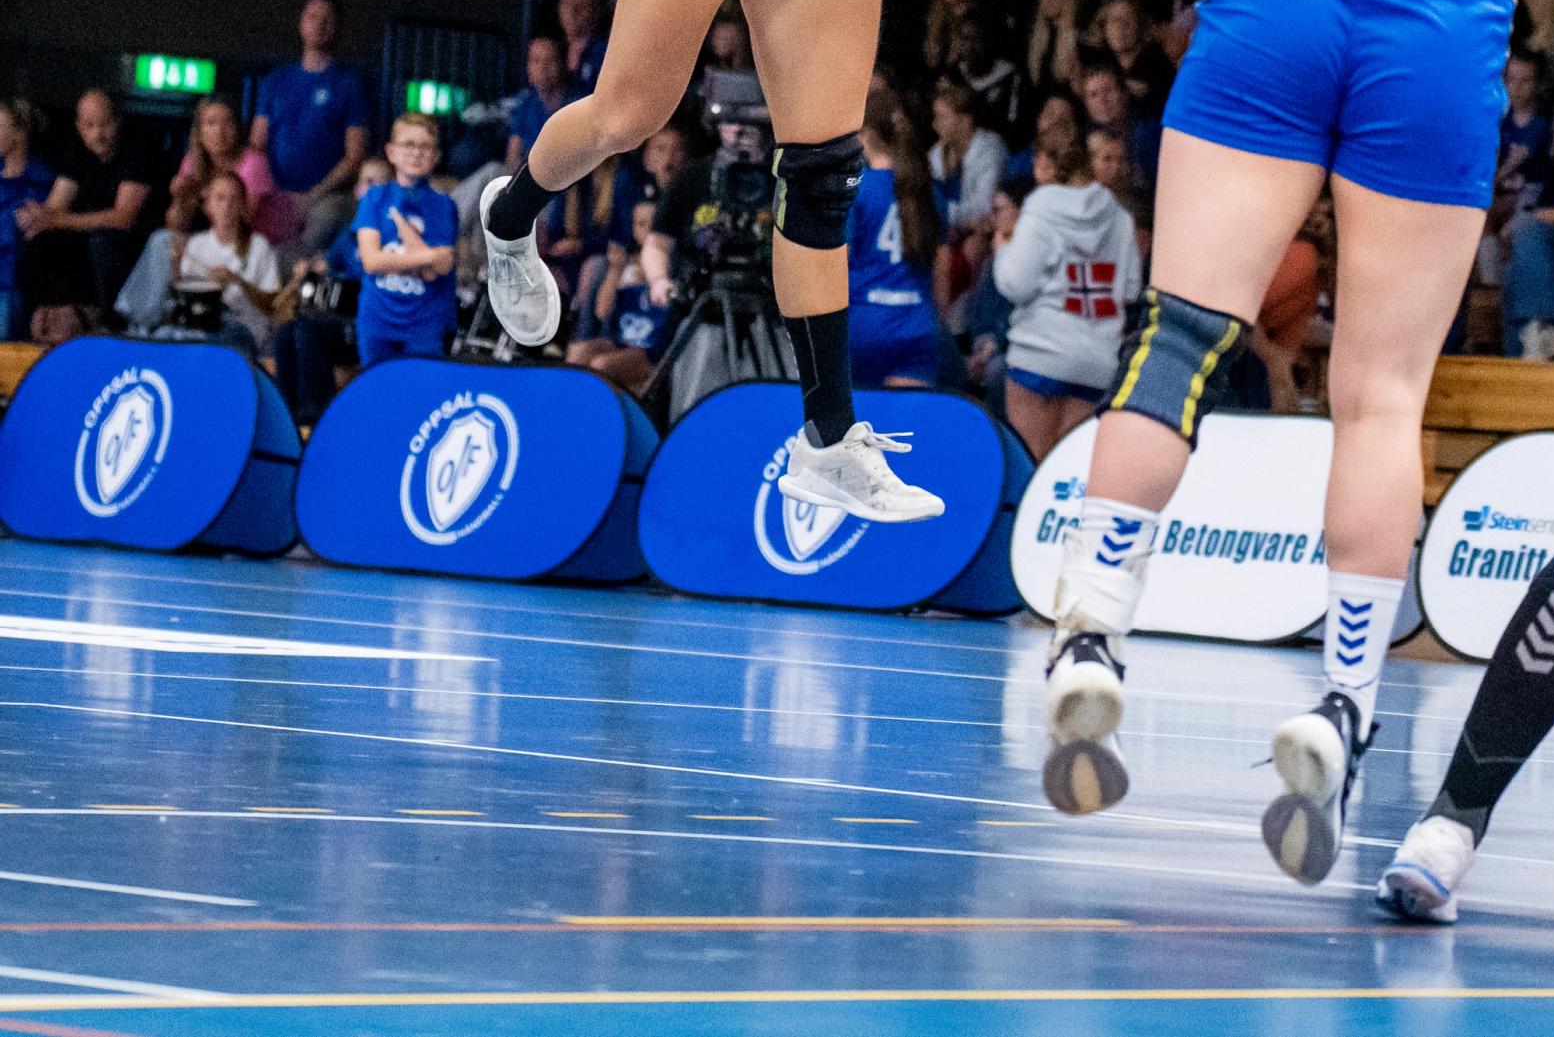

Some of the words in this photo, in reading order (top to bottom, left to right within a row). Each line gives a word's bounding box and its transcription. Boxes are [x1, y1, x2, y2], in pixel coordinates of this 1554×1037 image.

[409, 391, 473, 454] OPPSAL
[1163, 520, 1308, 565] Betongvare
[1311, 532, 1325, 565] A
